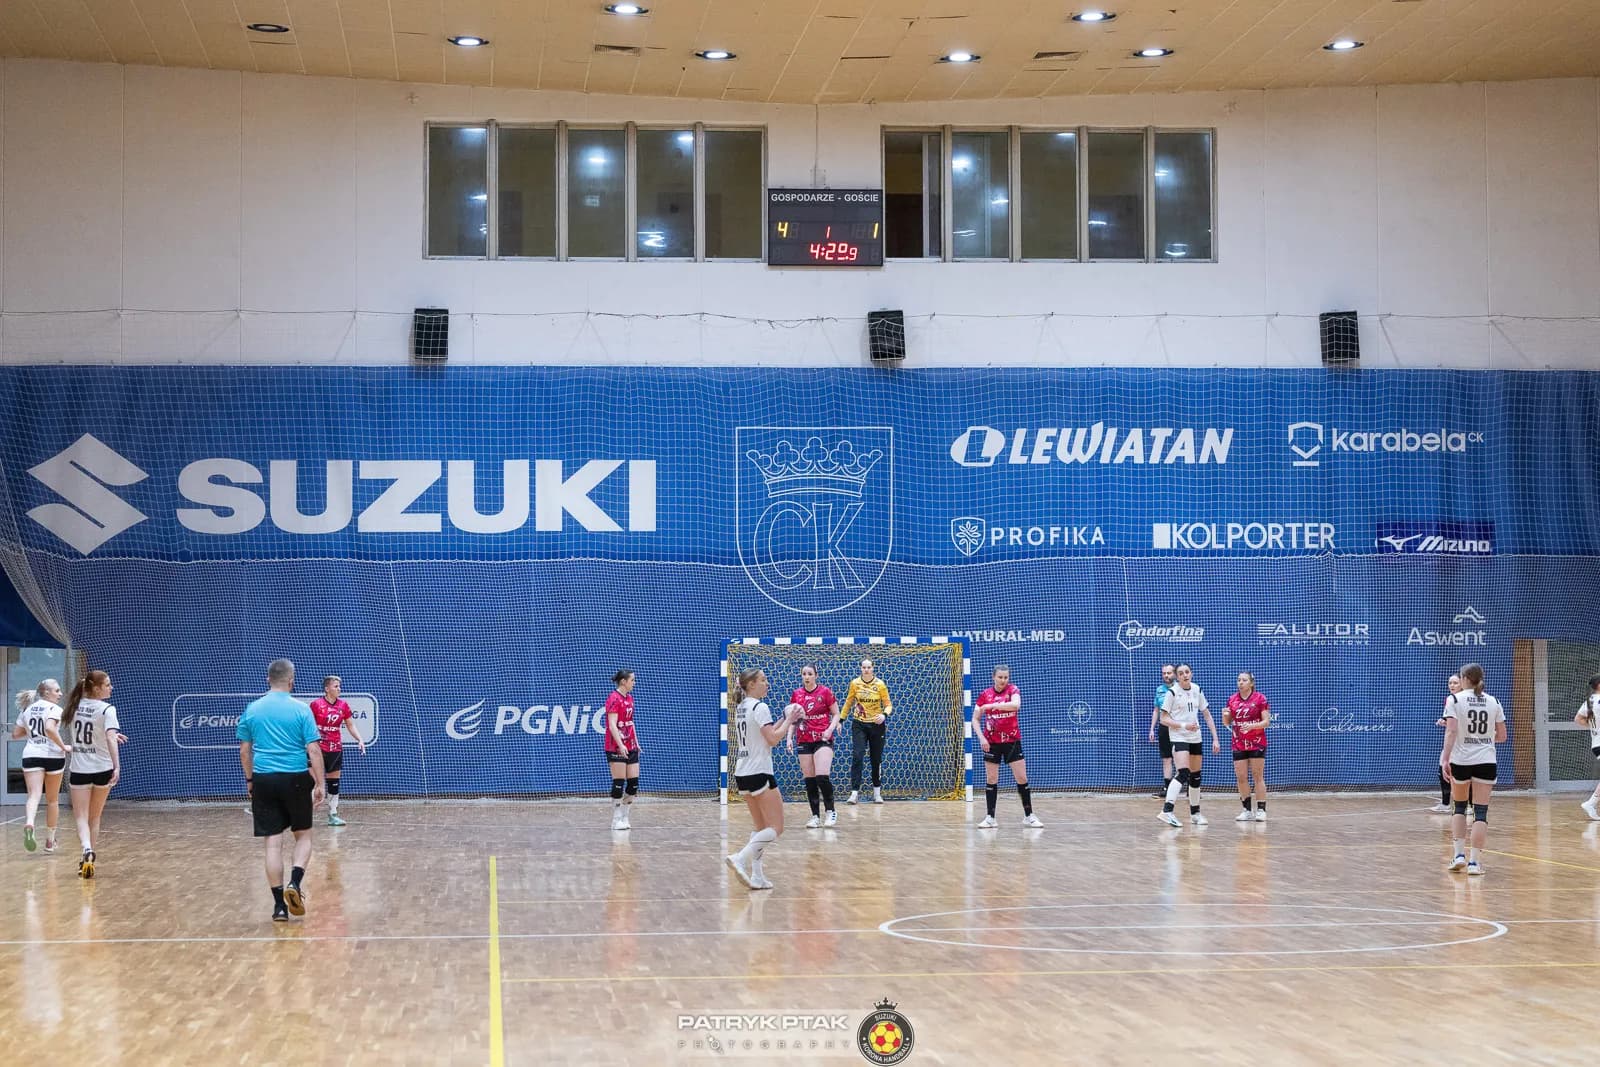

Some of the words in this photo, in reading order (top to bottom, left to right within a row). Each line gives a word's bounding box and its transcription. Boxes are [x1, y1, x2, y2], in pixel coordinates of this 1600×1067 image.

[770, 193, 835, 202] GOSPODARZE
[844, 191, 879, 202] GOŚCIE
[777, 221, 788, 238] 4
[826, 226, 831, 239] 1
[873, 222, 879, 239] 1
[1008, 422, 1234, 464] LEWIATAN
[1332, 428, 1466, 452] karabela
[177, 458, 657, 534] SUZUKI
[991, 526, 1105, 546] PROFIKA
[1172, 522, 1336, 549] KOLPORTER
[754, 501, 865, 590] CK
[952, 630, 1065, 642] NATURAL-MED
[1126, 626, 1204, 637] endorfina
[1273, 623, 1369, 635] ALUTOR
[1407, 627, 1486, 646] Aswent
[1187, 702, 1194, 712] 11
[1235, 708, 1250, 719] 22
[29, 717, 46, 739] 20
[327, 714, 339, 725] 19
[1467, 709, 1488, 735] 38
[74, 720, 93, 745] 26
